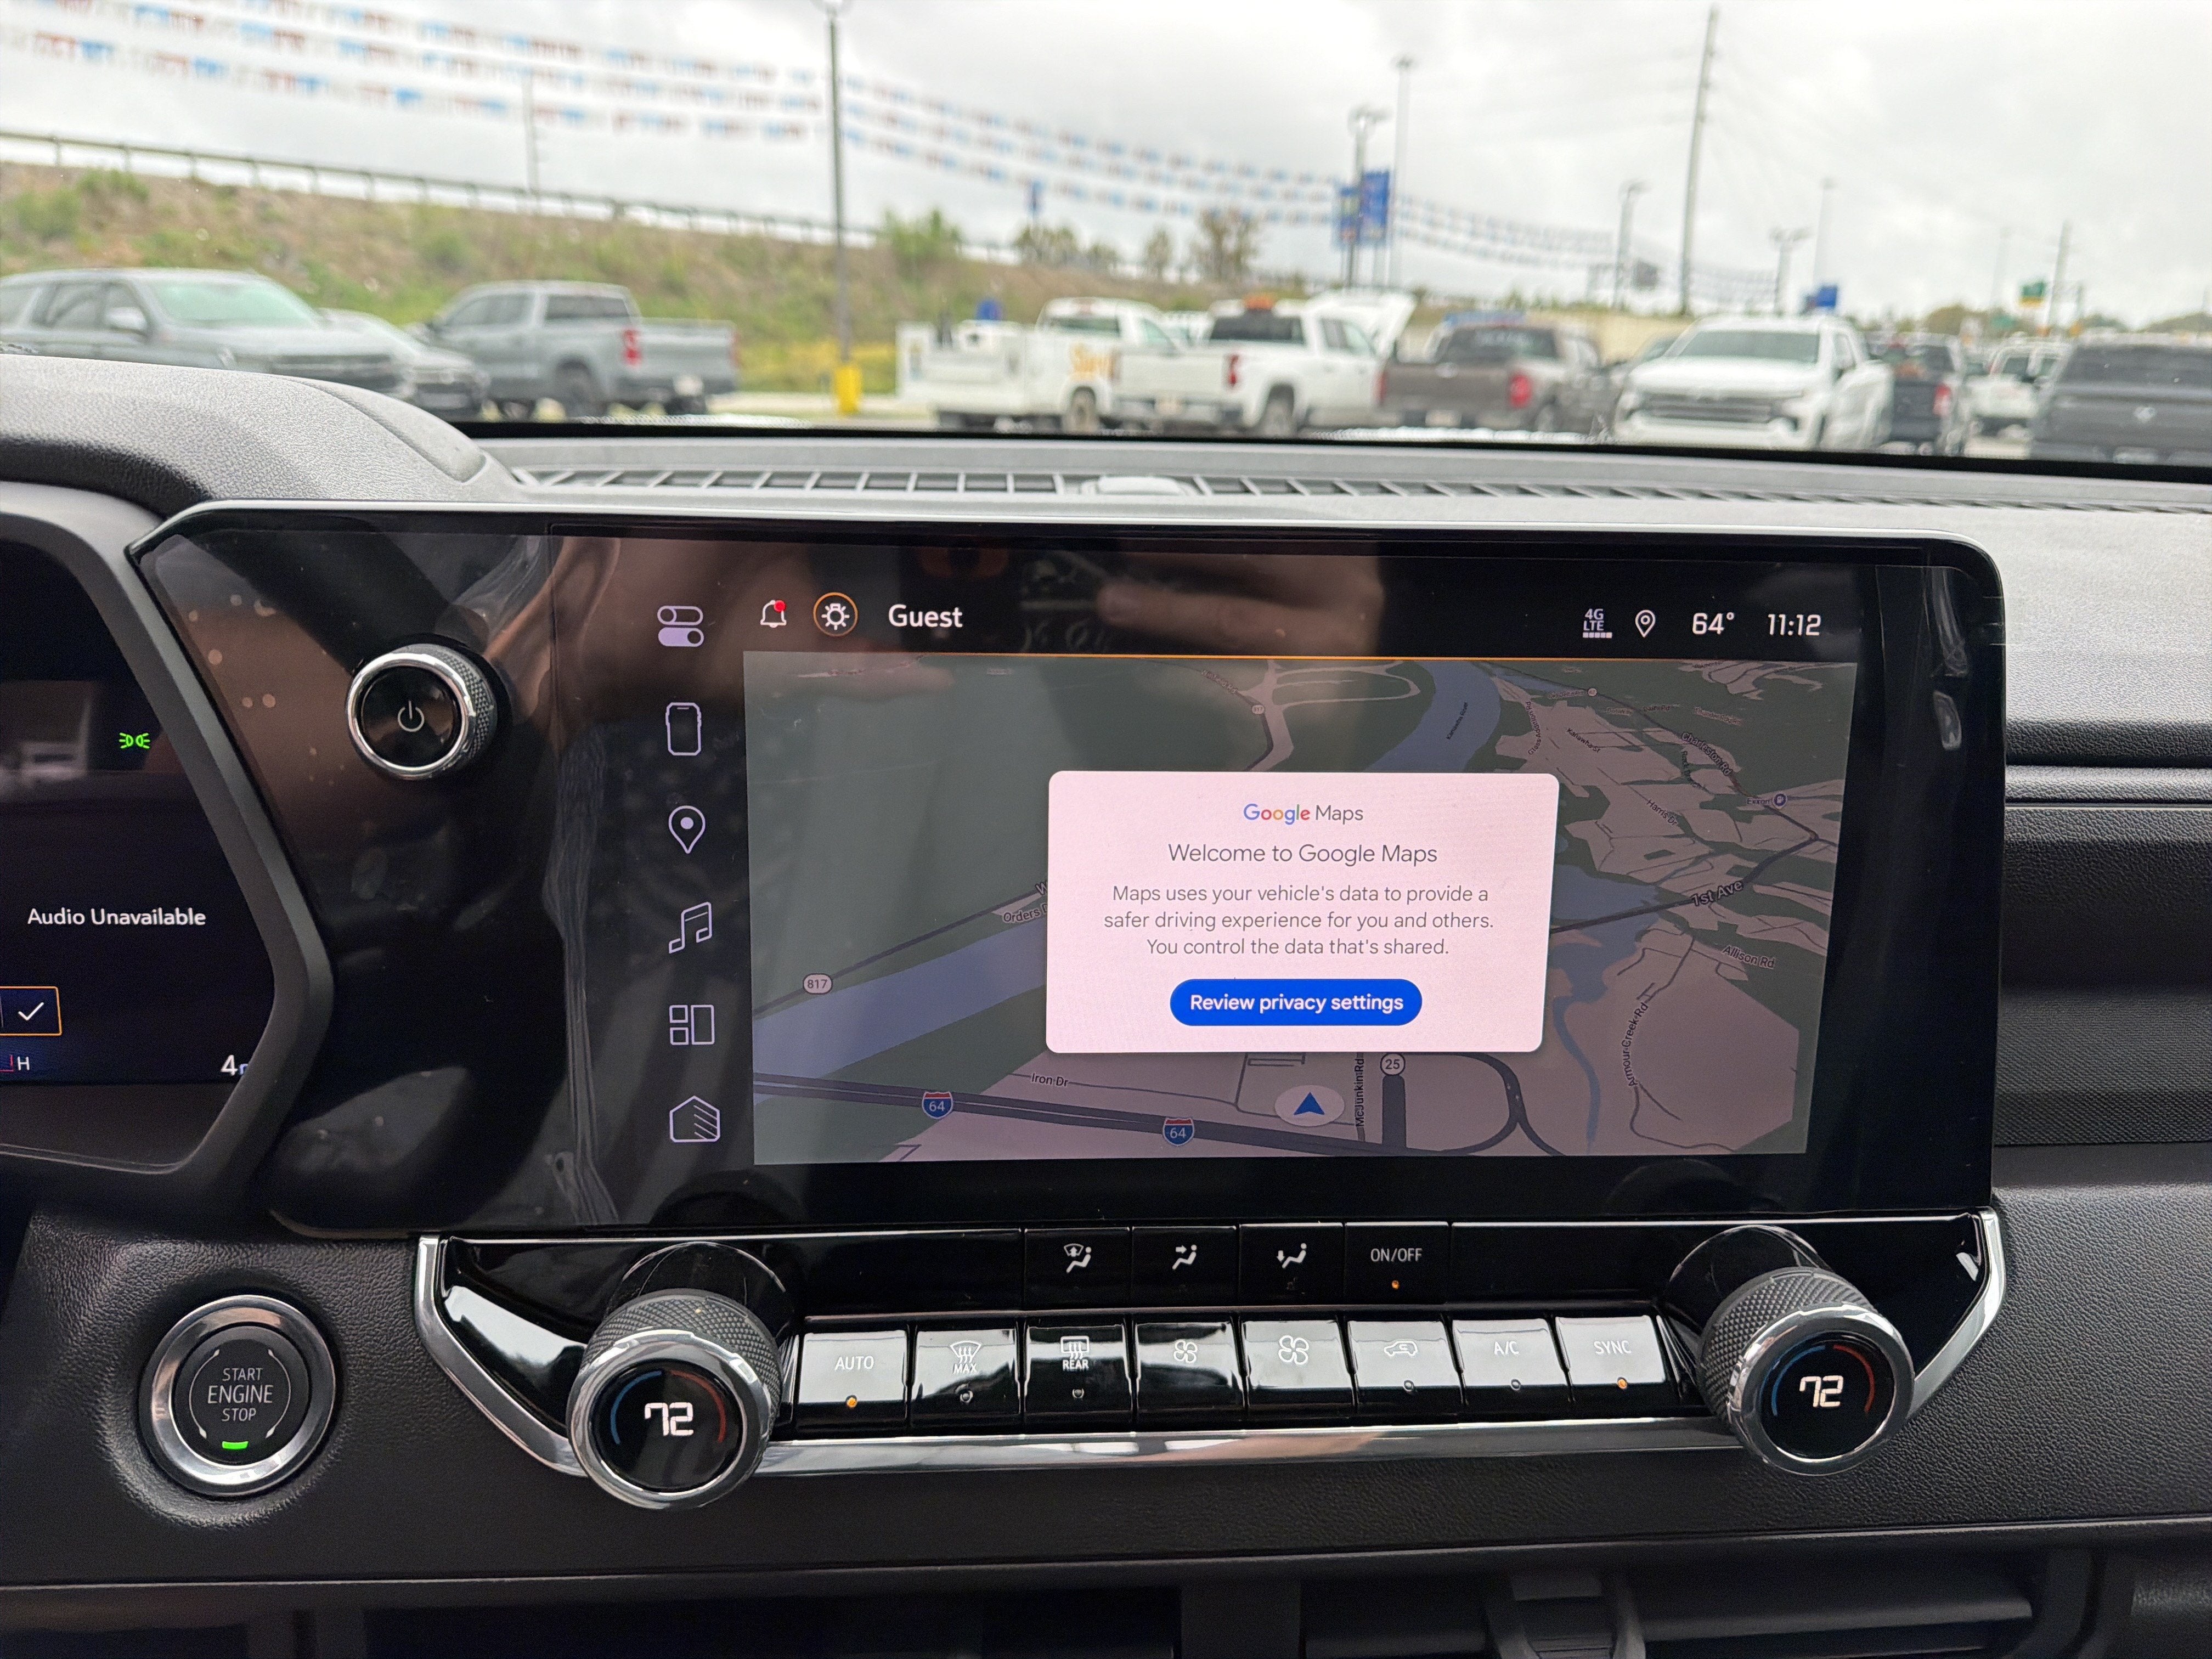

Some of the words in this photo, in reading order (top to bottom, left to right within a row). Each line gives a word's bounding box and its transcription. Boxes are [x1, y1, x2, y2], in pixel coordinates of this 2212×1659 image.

[889, 604, 962, 628] Guest
[1584, 608, 1604, 620] 4G
[1583, 620, 1604, 631] LTE
[1692, 612, 1735, 635] 64°
[1768, 613, 1821, 636] 11:12
[1525, 701, 1532, 710] Rd
[1528, 738, 1542, 755] Glass
[1567, 727, 1592, 750] Kanawha
[1590, 745, 1600, 753] St
[1682, 732, 1722, 766] Charleston
[1720, 762, 1731, 776] Rd
[1243, 803, 1311, 825] Google
[1316, 804, 1364, 825] Maps
[1647, 799, 1668, 819] Harris
[1667, 815, 1678, 826] Dr
[1168, 843, 1266, 862] Welcome
[1272, 845, 1293, 862] to
[1299, 844, 1375, 867] Google
[1382, 844, 1437, 867] Maps
[1113, 885, 1161, 905] Maps
[1166, 889, 1207, 901] uses
[1212, 889, 1252, 905] your
[1257, 884, 1335, 901] vehicle's
[1339, 884, 1379, 901] data
[1384, 887, 1402, 901] to
[1406, 885, 1473, 905] provide
[1478, 889, 1488, 902] a
[1691, 891, 1714, 906] 1st
[1718, 881, 1743, 900] Ave
[27, 907, 86, 925] Audio
[91, 907, 206, 926] Unavailable
[1003, 908, 1041, 922] Orders
[1104, 911, 1150, 928] safer
[1155, 911, 1216, 932] driving
[1221, 911, 1322, 932] experience
[1327, 911, 1352, 928] for
[1356, 916, 1388, 932] you
[1394, 911, 1427, 928] and
[1432, 911, 1493, 928] others.
[1147, 939, 1178, 955] You
[1183, 938, 1245, 955] control
[1250, 938, 1279, 955] the
[1284, 938, 1323, 955] data
[1329, 938, 1379, 955] that's
[1384, 938, 1449, 955] shared.
[1722, 945, 1757, 964] Allison
[1759, 956, 1775, 968] Rd
[807, 979, 828, 989] 817
[1190, 993, 1255, 1011] Review
[1260, 993, 1327, 1014] privacy
[1330, 993, 1404, 1014] settings
[1634, 1002, 1649, 1018] Rd
[1621, 1019, 1638, 1048] Creek
[17, 1056, 30, 1071] H
[1354, 1058, 1364, 1072] Rd
[1385, 1059, 1400, 1070] 25
[1623, 1049, 1638, 1087] Armour
[1031, 1073, 1053, 1085] Iron
[1056, 1076, 1069, 1087] Dr
[929, 1101, 945, 1112] 64
[1353, 1075, 1364, 1127] McJunkin
[1170, 1127, 1186, 1138] 64
[1370, 1248, 1423, 1262] ON/OFF
[1494, 1341, 1519, 1355] A/C
[1594, 1340, 1632, 1355] SYNC
[834, 1356, 874, 1371] AUTO
[953, 1363, 978, 1374] MAX
[1062, 1359, 1090, 1371] REAR
[222, 1367, 263, 1381] START
[207, 1384, 274, 1404] ENGINE
[1799, 1375, 1844, 1408] 72
[222, 1407, 257, 1422] STOP
[644, 1402, 694, 1436] 72
